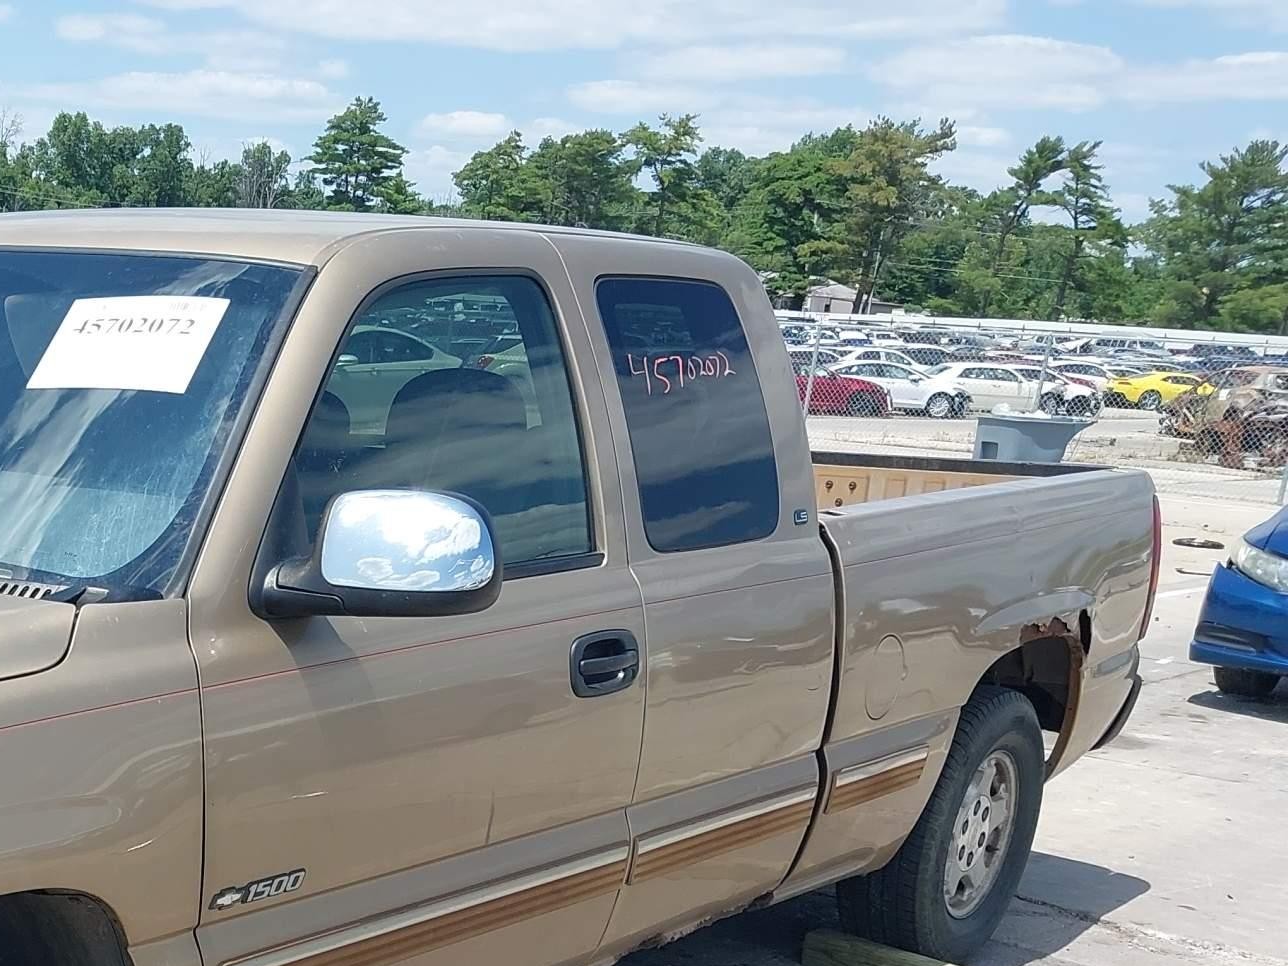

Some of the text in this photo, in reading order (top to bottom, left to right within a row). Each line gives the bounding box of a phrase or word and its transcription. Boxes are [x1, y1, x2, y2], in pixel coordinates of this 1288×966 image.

[73, 317, 196, 335] 45702072
[627, 350, 737, 396] 45702072
[794, 510, 808, 523] LS
[246, 870, 306, 903] 1500
